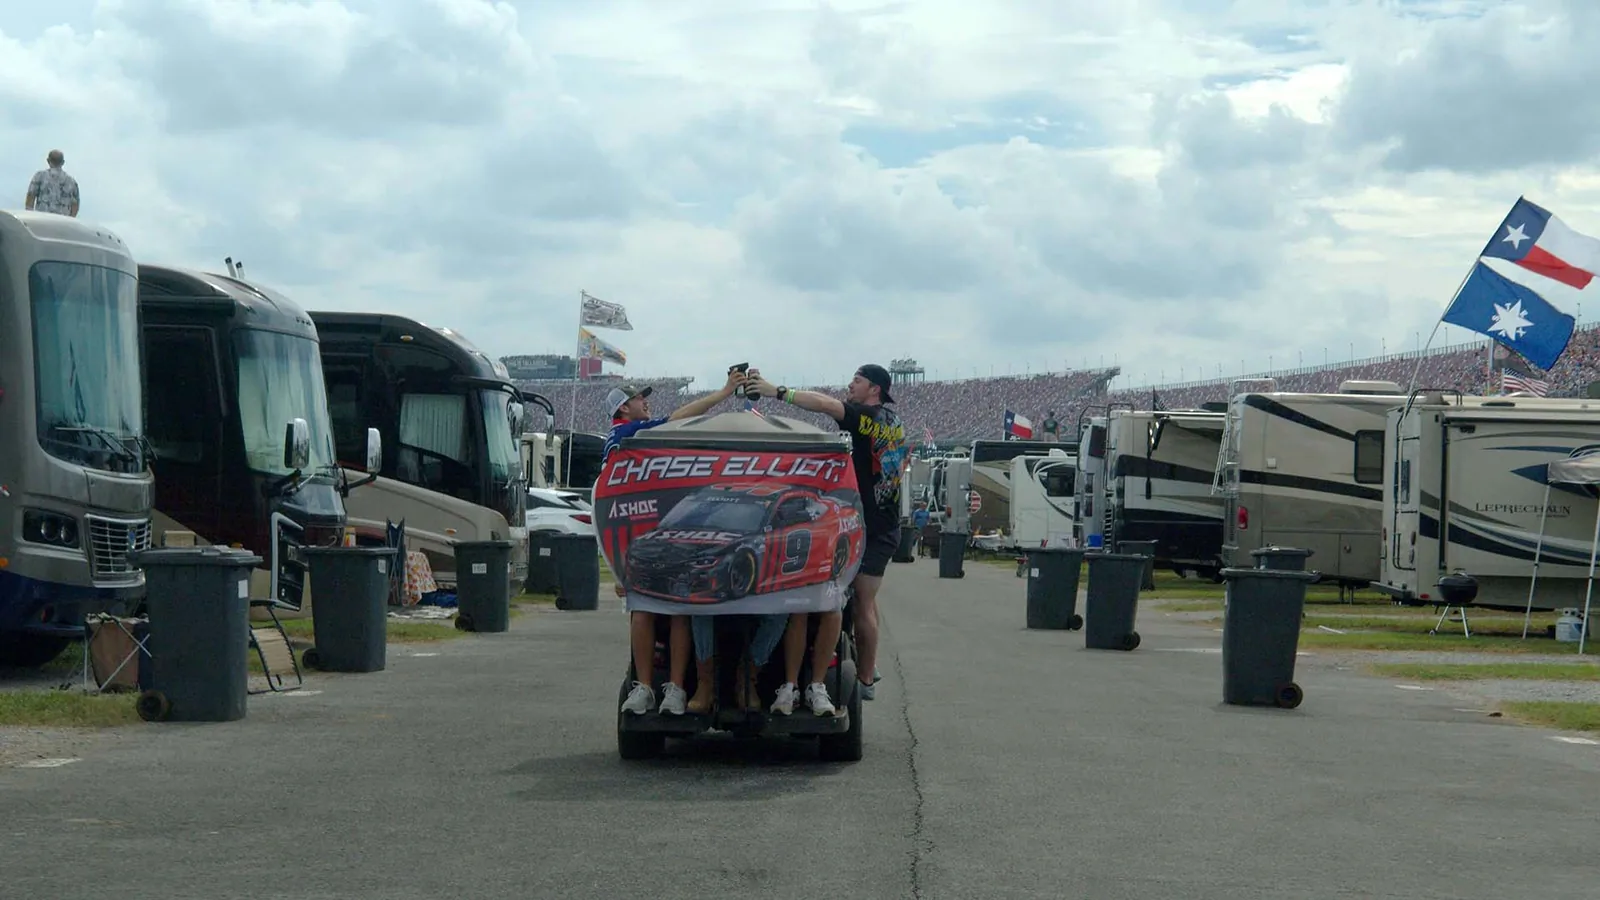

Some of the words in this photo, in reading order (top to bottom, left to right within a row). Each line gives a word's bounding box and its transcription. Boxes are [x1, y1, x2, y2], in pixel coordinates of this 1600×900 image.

[607, 456, 720, 486] CHASE
[1475, 503, 1570, 515] LEPRECHAUN
[781, 529, 812, 575] 9
